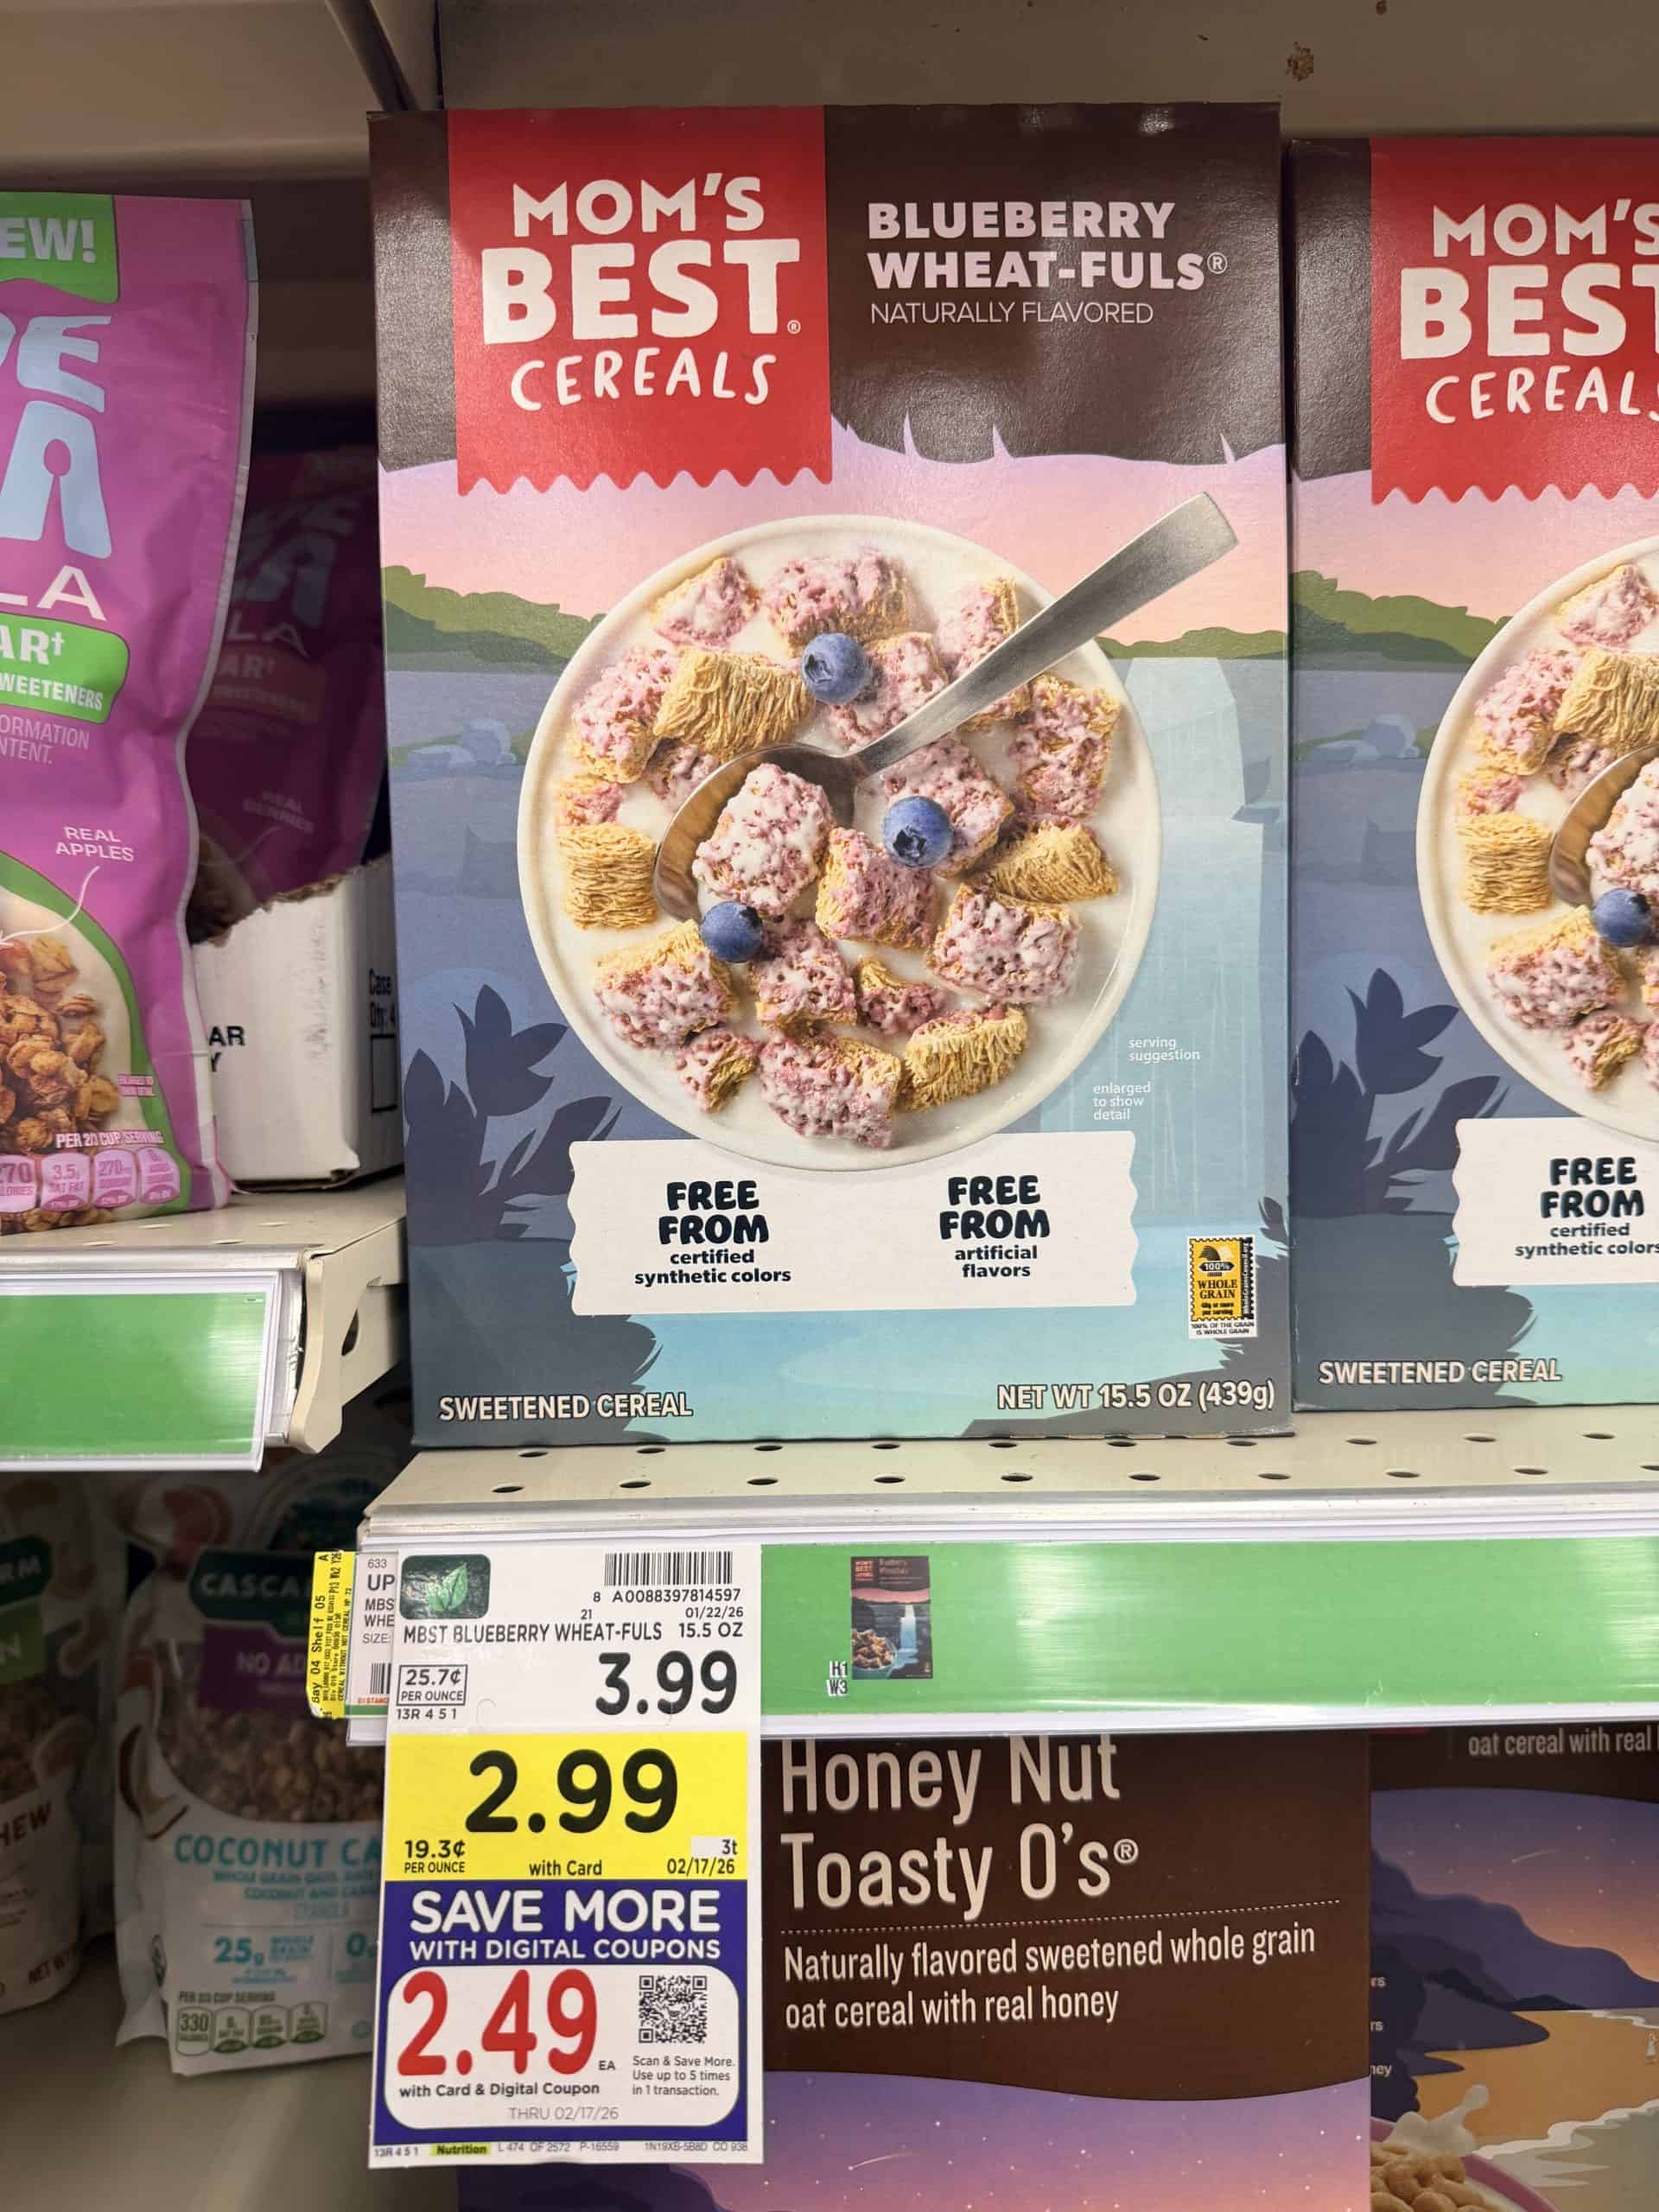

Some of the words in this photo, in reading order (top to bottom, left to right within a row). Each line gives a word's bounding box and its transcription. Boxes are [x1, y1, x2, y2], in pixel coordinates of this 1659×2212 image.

[513, 172, 765, 238] MOM'S
[868, 200, 1175, 239] BLUEBERRY
[1433, 198, 1659, 257] MOM'S
[871, 301, 1015, 324] NATURALLY
[1022, 301, 1154, 324] FLAVORED
[511, 347, 777, 411] CEREALS
[63, 826, 122, 842] REAL
[55, 842, 135, 862] APPLES
[208, 1026, 246, 1047] AR
[1128, 1037, 1176, 1051] serving
[1128, 1050, 1201, 1064] suggestion
[1093, 1082, 1151, 1096] enlarged
[1093, 1096, 1107, 1107] to
[1109, 1096, 1145, 1107] show
[1093, 1108, 1131, 1120] detail
[56, 1133, 83, 1148] PER
[1549, 1156, 1637, 1186] FREE
[666, 1180, 760, 1211] FREE
[947, 1174, 1041, 1205] FREE
[1539, 1189, 1644, 1218] FROM
[658, 1214, 770, 1245] FROM
[939, 1209, 1051, 1240] FROM
[1549, 1223, 1630, 1238] certified
[670, 1249, 755, 1264] certified
[955, 1244, 1038, 1261] artificial
[1514, 1242, 1603, 1259] synthetic
[1606, 1240, 1659, 1255] colors
[634, 1268, 727, 1287] synthetic
[731, 1268, 792, 1283] colors
[962, 1263, 1031, 1278] flavors
[1198, 1280, 1237, 1289] WHOLE
[1199, 1289, 1236, 1300] GRAIN
[1318, 1360, 1466, 1385] SWEETENED
[1470, 1358, 1563, 1382] CEREAL
[997, 1384, 1047, 1409] NET
[1052, 1384, 1093, 1409] WT
[1098, 1382, 1152, 1409] 15.5
[1158, 1382, 1192, 1408] OZ
[1198, 1378, 1276, 1413] (439g)
[439, 1395, 590, 1421] SWEETENED
[596, 1392, 694, 1418] CEREAL
[367, 1559, 388, 1569] 633
[315, 1595, 326, 1609] 05
[593, 1592, 601, 1602] 8
[612, 1589, 741, 1603] A0088397814597
[581, 1609, 593, 1620] 21
[685, 1606, 744, 1620] 01/22/26
[312, 1618, 325, 1652] Shelf
[403, 1624, 448, 1643] MBST
[454, 1624, 550, 1643] BLUEBERRY
[555, 1623, 662, 1641] WHEAT-FULS
[678, 1622, 711, 1638] 15.5
[717, 1623, 744, 1637] OZ
[311, 1661, 321, 1675] 04
[595, 1649, 738, 1715] 3.99
[401, 1690, 422, 1702] PER
[424, 1689, 463, 1701] OUNCE
[397, 1708, 421, 1722] 13R
[1469, 1732, 1500, 1756] oat
[1504, 1727, 1563, 1755] cereal
[1569, 1726, 1611, 1753] with
[1616, 1725, 1652, 1752] real
[781, 1738, 982, 1825] Honey
[1009, 1733, 1122, 1804] Nut
[466, 1748, 678, 1834] 2.99
[175, 1832, 329, 1867] COCONUT
[404, 1861, 425, 1873] PER
[428, 1861, 466, 1873] OUNCE
[529, 1859, 563, 1876] with
[567, 1859, 602, 1876] Card
[666, 1859, 735, 1875] 02/17/26
[780, 1831, 993, 1921] Toasty
[410, 1889, 543, 1934] SAVE
[564, 1889, 721, 1932] MORE
[410, 1940, 477, 1961] WITH
[486, 1939, 586, 1961] DIGITAL
[594, 1938, 721, 1960] COUPONS
[784, 1942, 904, 1986] Naturally
[912, 1938, 1017, 1979] flavored
[1025, 1929, 1163, 1972] sweetened
[1170, 1924, 1245, 1962] whole
[1252, 1921, 1315, 1965] grain
[785, 1997, 827, 2031] oat
[834, 1990, 914, 2027] cereal
[920, 1987, 977, 2024] with
[985, 1986, 1033, 2022] real
[1040, 1983, 1119, 2023] honey
[397, 1968, 598, 2076] 2.49
[599, 2060, 616, 2071] EA
[632, 2055, 659, 2067] Scan
[663, 2056, 671, 2066] &
[675, 2055, 701, 2067] Save
[704, 2055, 735, 2067] More.
[632, 2070, 652, 2082] Use
[657, 2073, 669, 2084] up
[672, 2071, 686, 2082] to
[690, 2070, 696, 2082] 5
[700, 2069, 731, 2082] times
[399, 2084, 432, 2098] with
[435, 2083, 471, 2097] Card
[475, 2084, 485, 2095] &
[489, 2082, 537, 2098] Digital
[542, 2082, 600, 2098] Coupon
[632, 2085, 643, 2095] in
[653, 2084, 720, 2096] transaction.
[509, 2107, 550, 2121] THRU
[554, 2107, 620, 2121] 02/17/26
[436, 2144, 487, 2155] Nutrition
